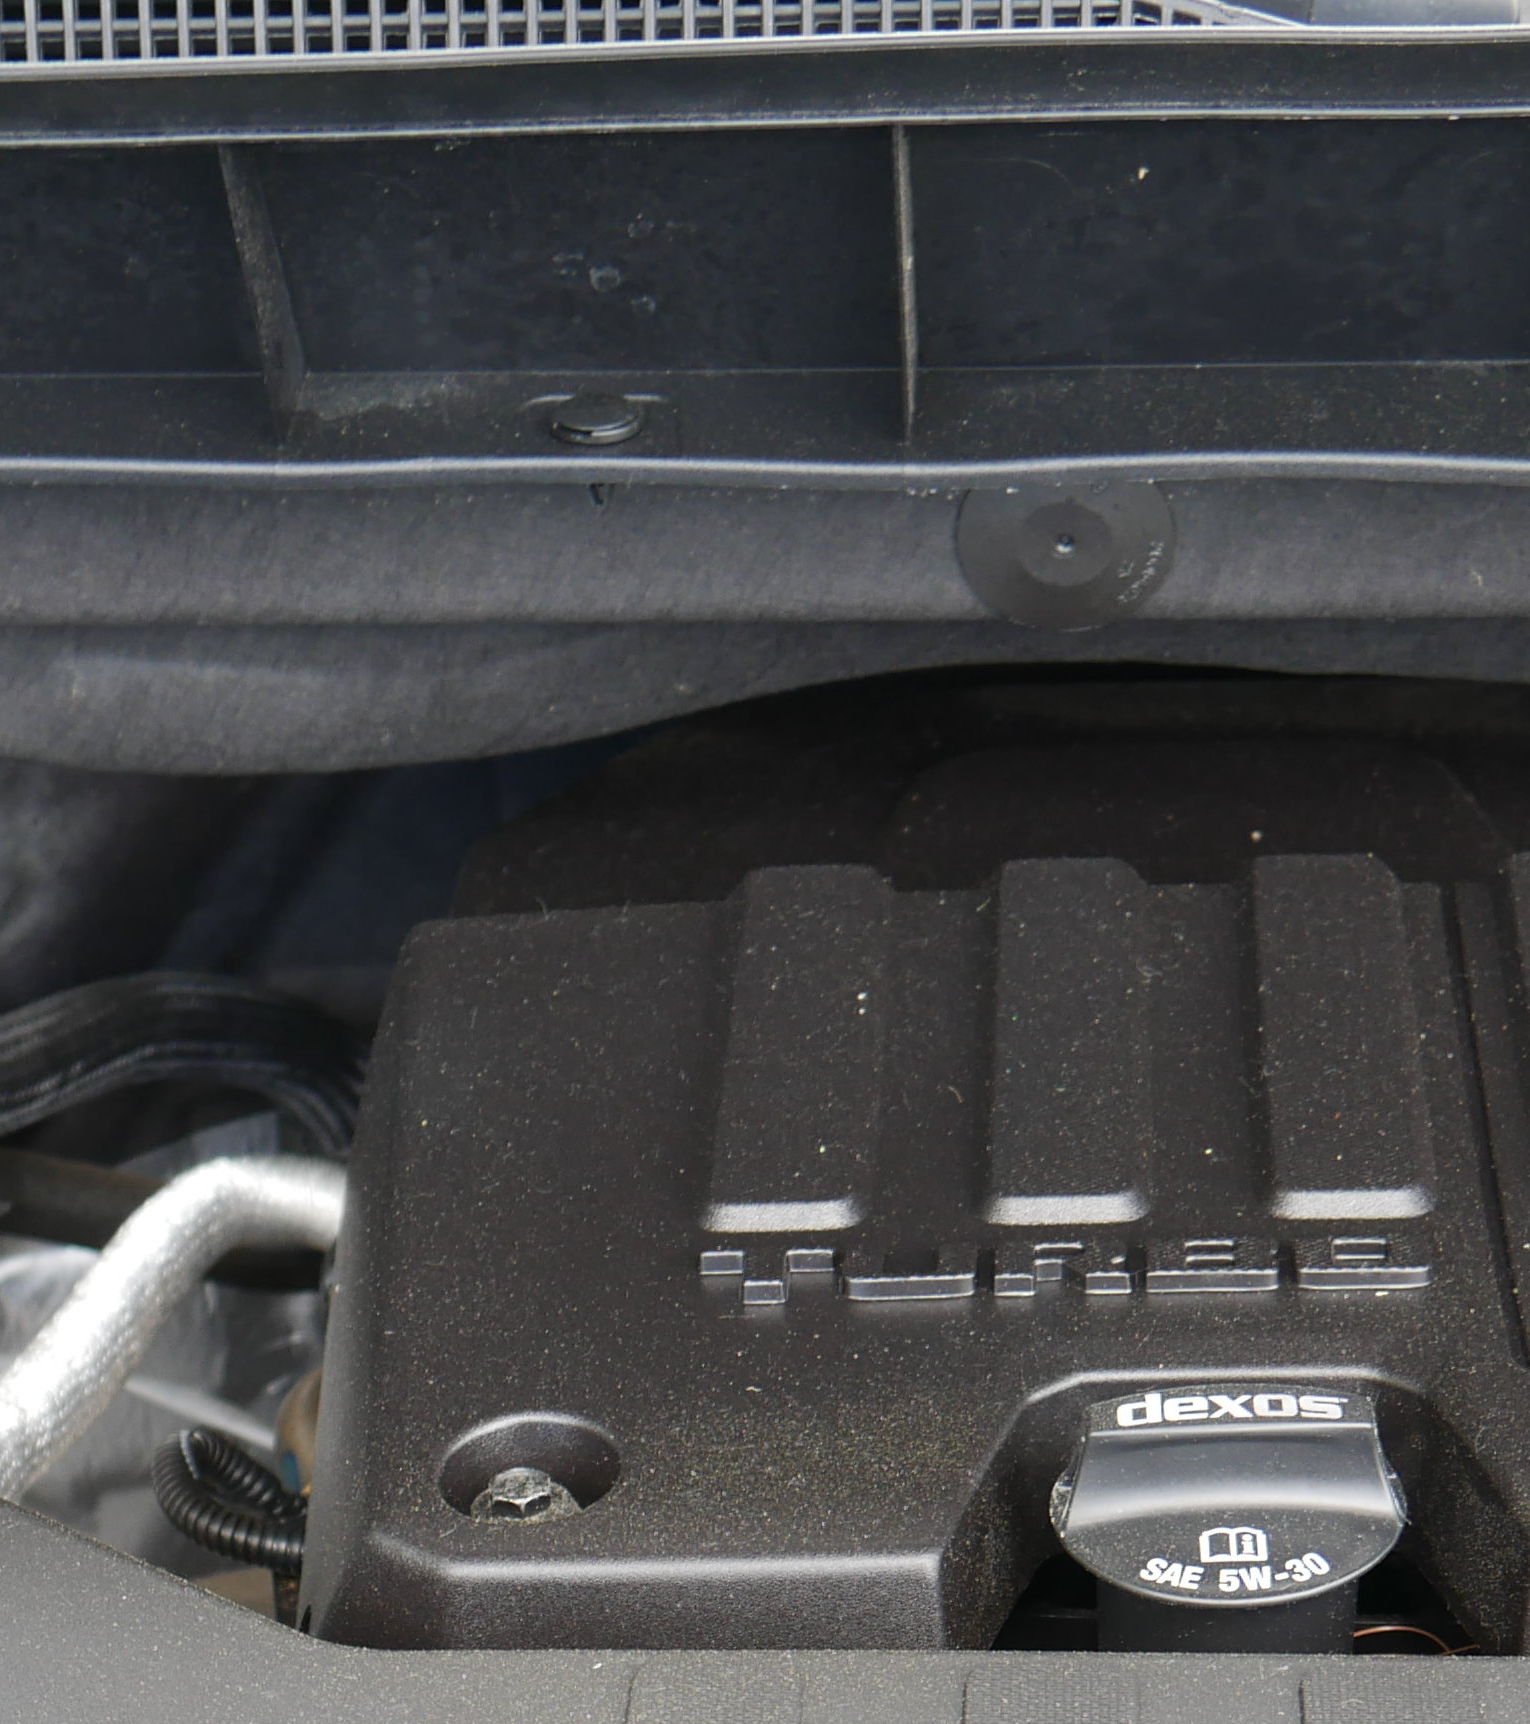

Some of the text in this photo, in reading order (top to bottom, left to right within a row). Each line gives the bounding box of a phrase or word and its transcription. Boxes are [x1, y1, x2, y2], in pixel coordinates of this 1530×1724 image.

[698, 1230, 1432, 1306] TURBO
[1116, 1392, 1345, 1428] dexos
[1139, 1552, 1332, 1593] SAE 5W-30
